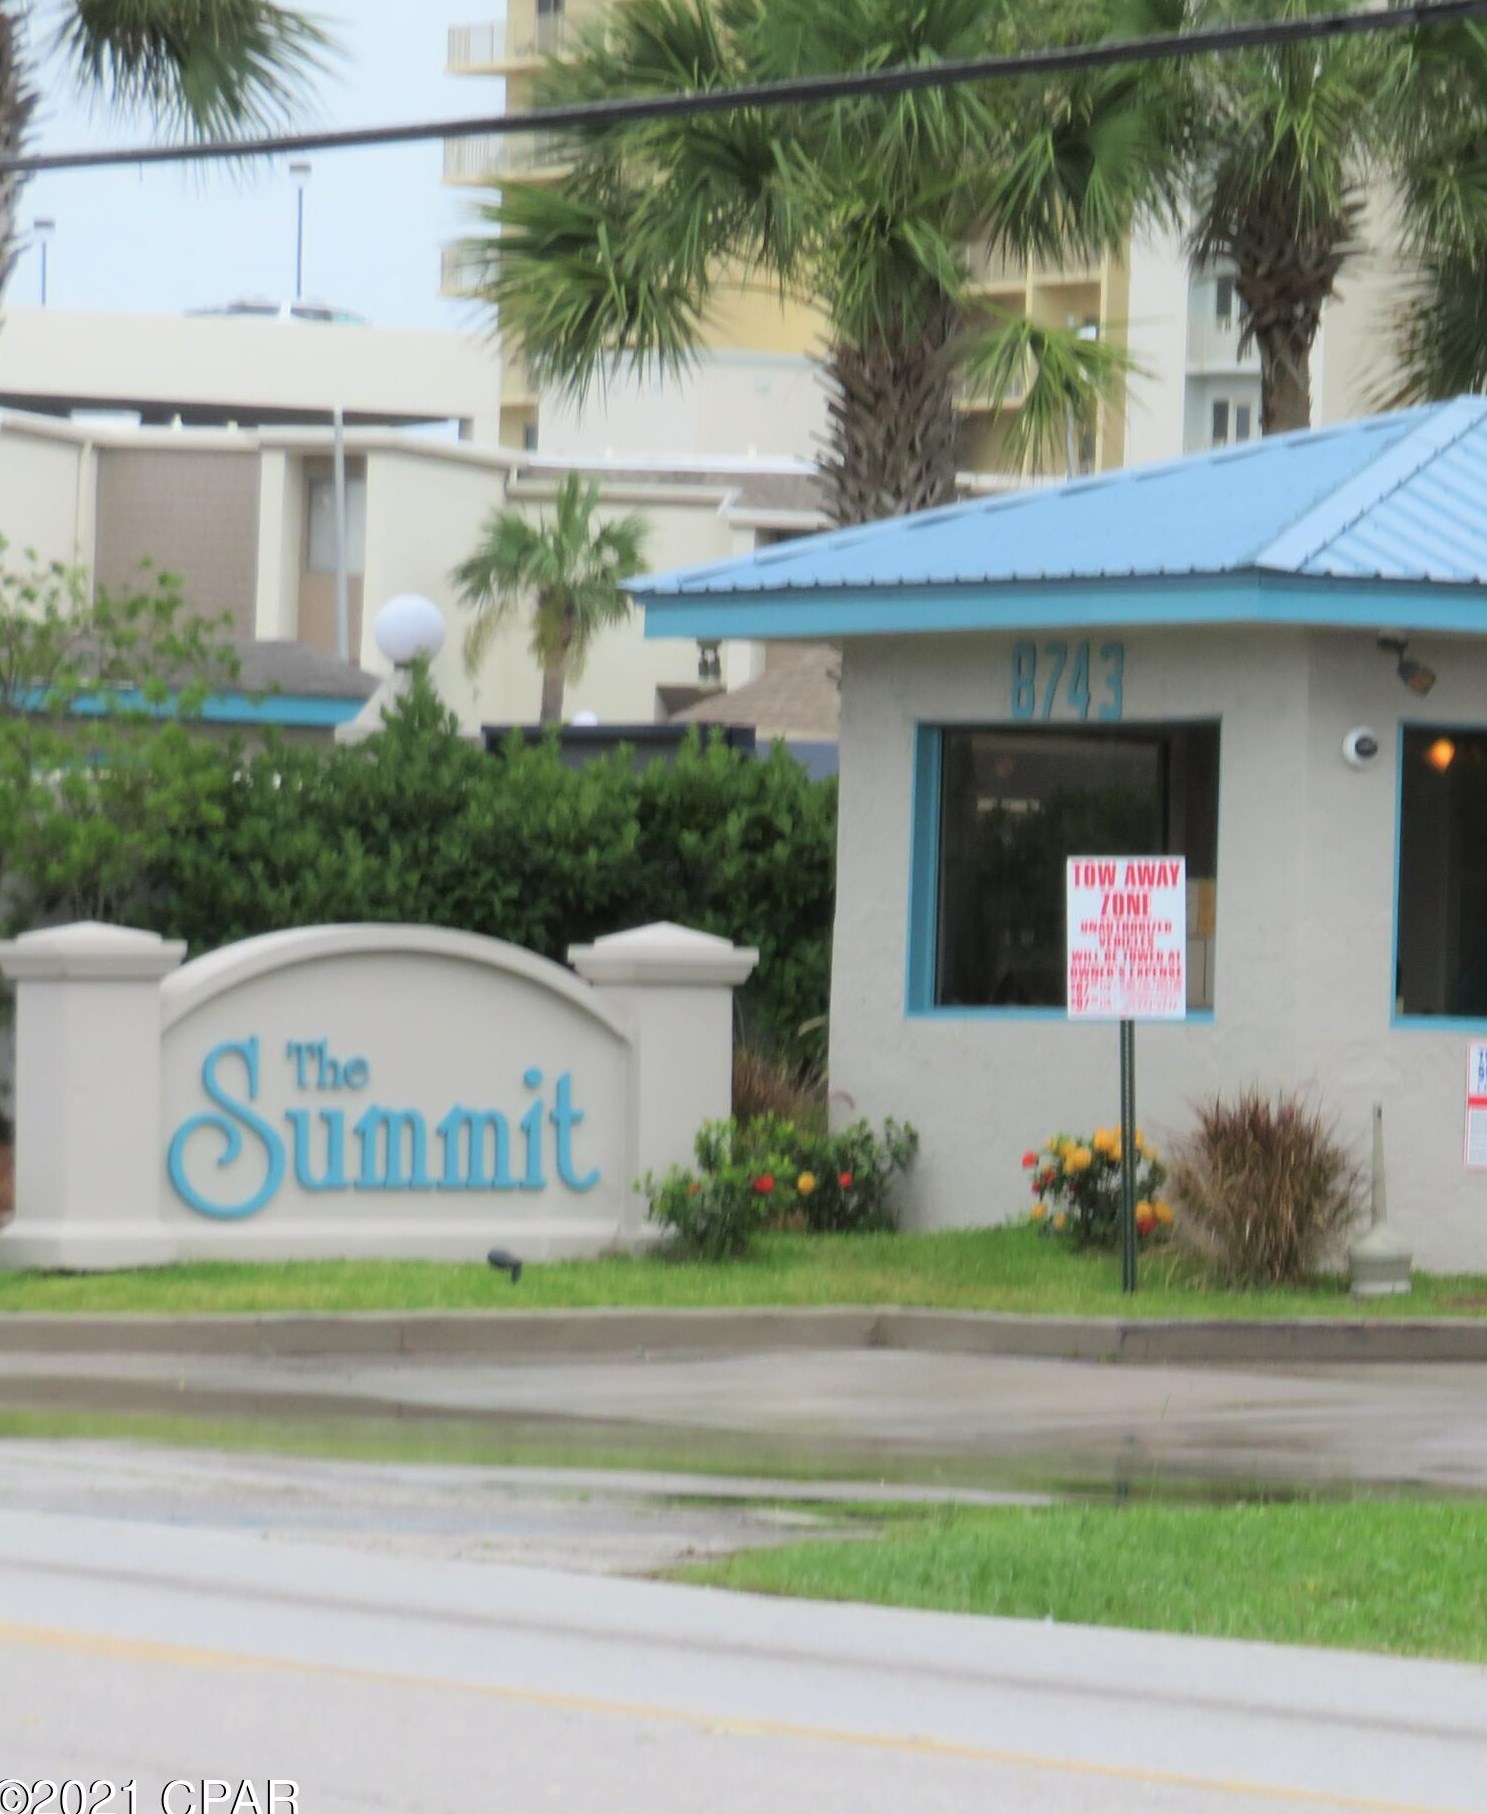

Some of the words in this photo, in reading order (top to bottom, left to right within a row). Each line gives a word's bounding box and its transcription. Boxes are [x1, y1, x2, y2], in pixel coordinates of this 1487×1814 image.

[1010, 640, 1125, 722] 8743
[1074, 861, 1117, 888] TOW
[1124, 861, 1180, 888] AWAY
[1101, 891, 1151, 917] ZONE
[1081, 920, 1172, 935] UNAUTHORIZED
[1099, 934, 1154, 949] VEHICLES
[1072, 950, 1098, 964] WILL
[1105, 950, 1117, 964] BE
[1123, 950, 1164, 964] TOWED
[1168, 950, 1181, 964] AT
[1130, 965, 1182, 979] EXPENSE
[286, 1036, 370, 1090] The
[166, 1034, 600, 1219] Summit
